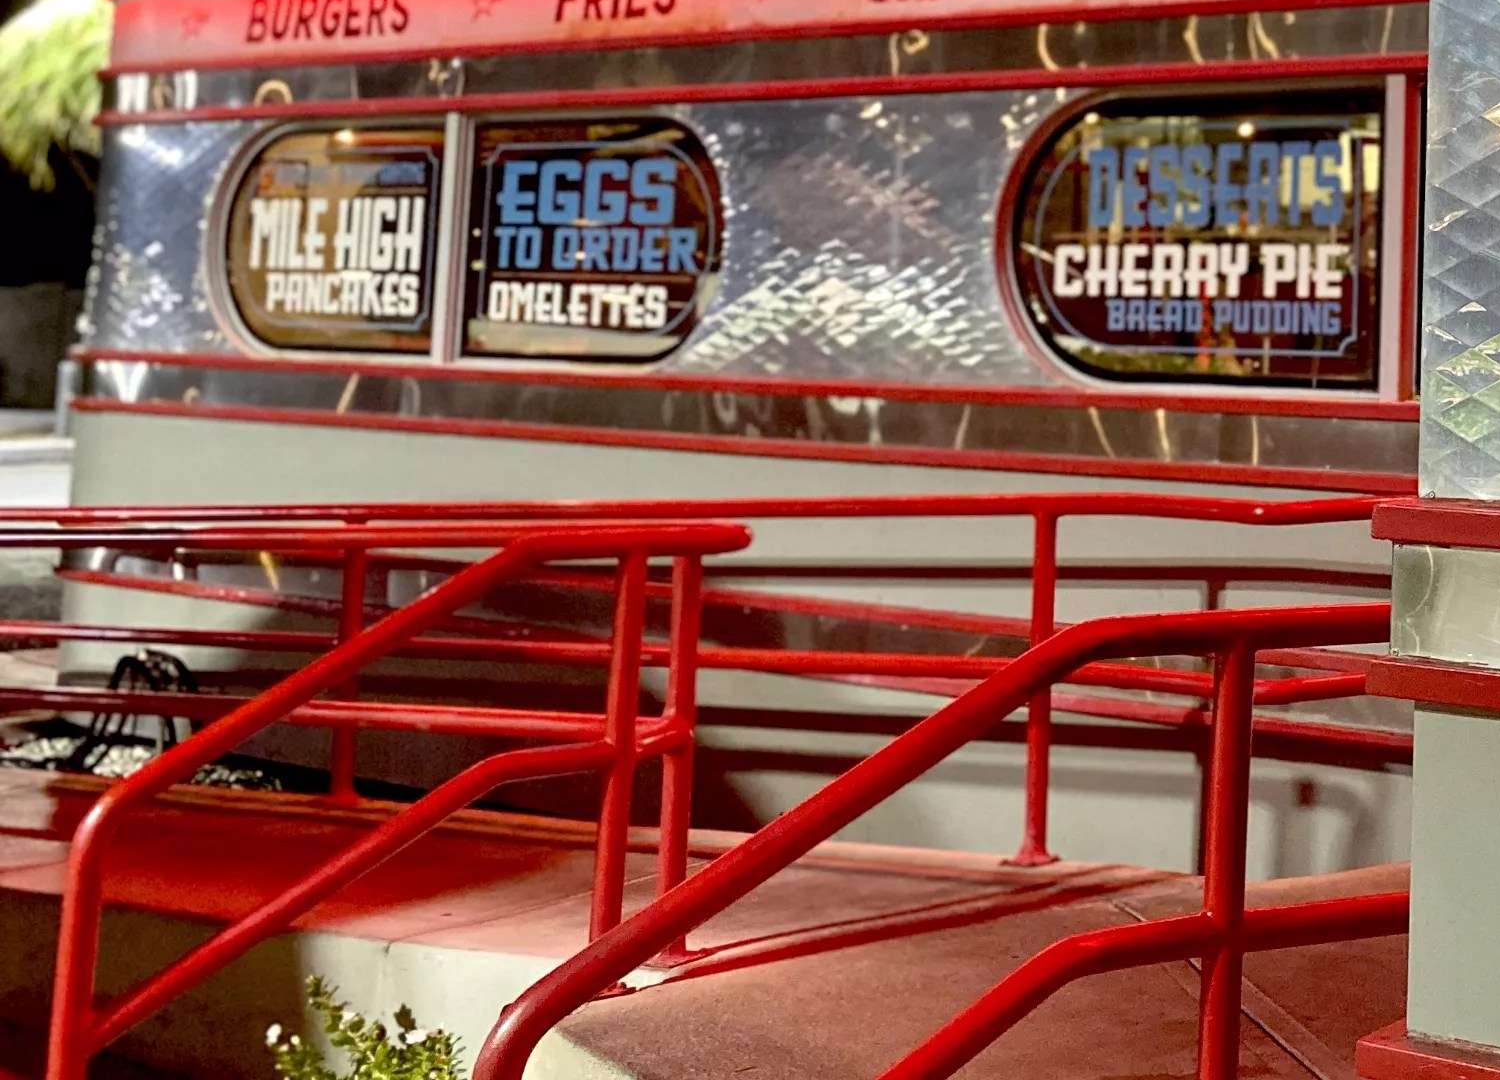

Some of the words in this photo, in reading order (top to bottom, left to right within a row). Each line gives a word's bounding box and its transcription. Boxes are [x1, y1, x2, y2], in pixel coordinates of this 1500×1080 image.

[496, 158, 678, 226] EGGS
[1088, 141, 1343, 228] DESSERTS
[249, 197, 329, 270] MILE
[335, 197, 426, 270] HIGH
[494, 227, 542, 270] TO
[552, 226, 699, 274] ORDER
[266, 270, 420, 318] PANCAKES
[1052, 242, 1249, 299] CHERRY
[1259, 243, 1344, 299] PIE
[489, 281, 668, 328] OMELETTES
[1105, 299, 1204, 333] BREAD
[1213, 299, 1342, 335] PUDDING
